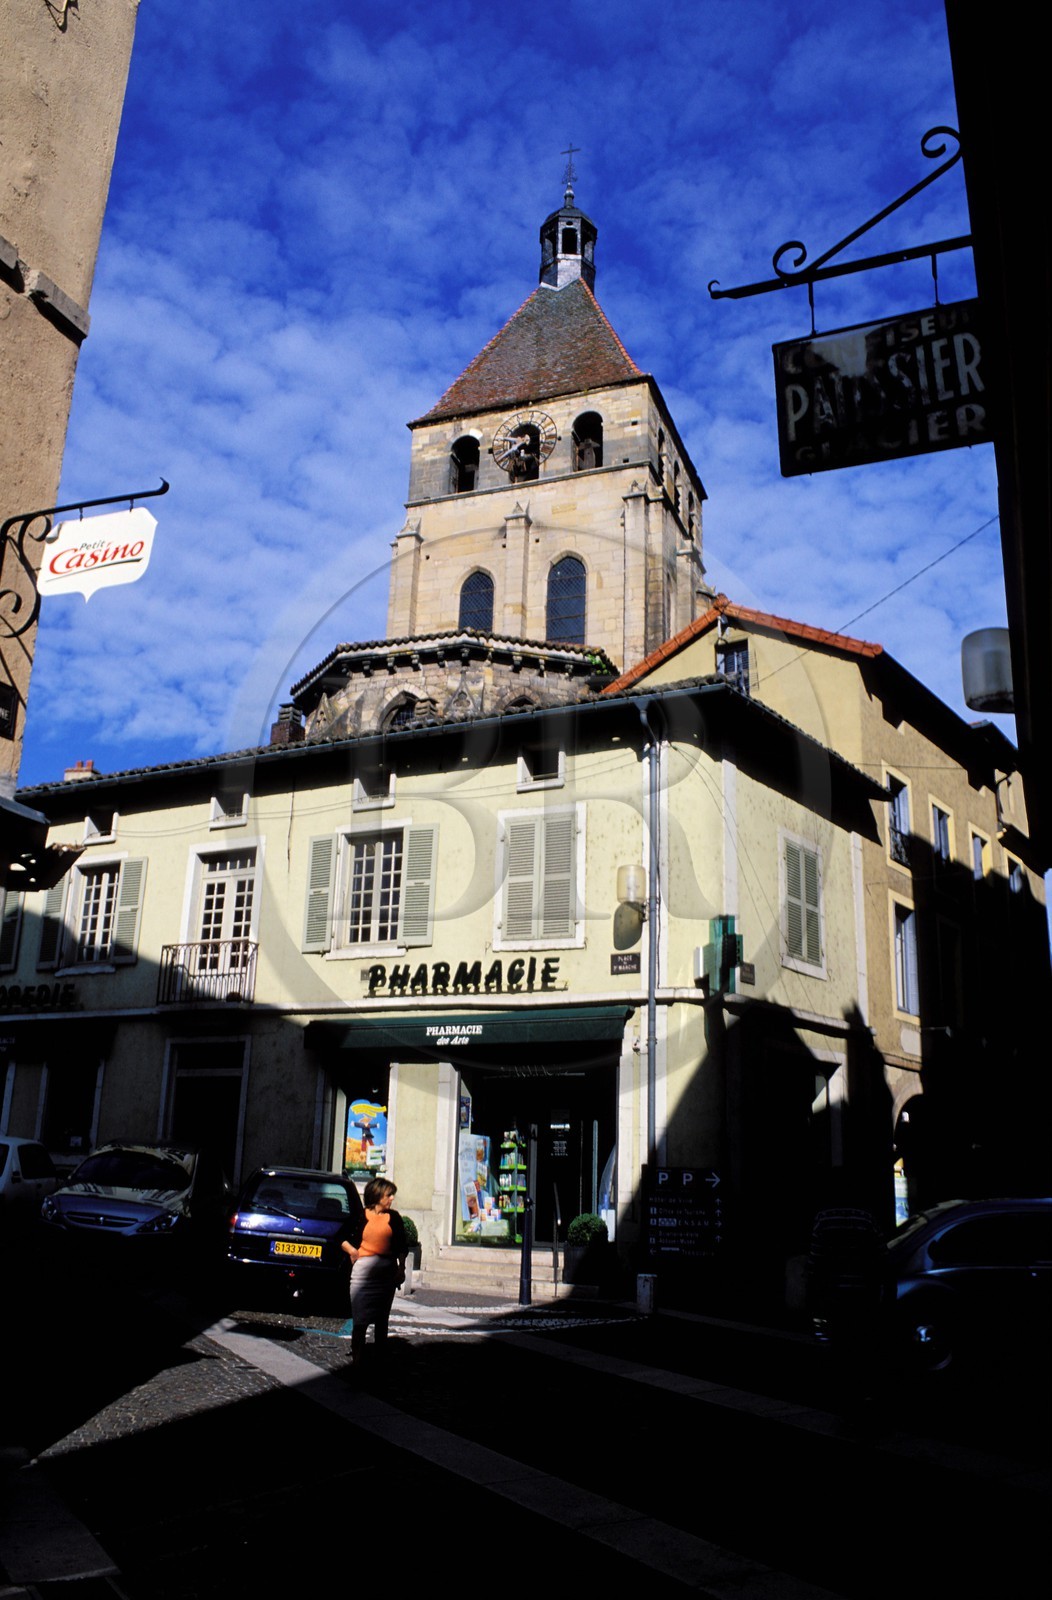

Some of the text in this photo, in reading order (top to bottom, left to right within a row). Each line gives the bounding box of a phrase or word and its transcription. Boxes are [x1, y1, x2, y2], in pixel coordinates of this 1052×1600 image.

[80, 540, 106, 551] Petit
[49, 540, 145, 575] Casino
[368, 956, 560, 990] PHARMACIE
[426, 1025, 483, 1036] PHARMACIE
[436, 1035, 469, 1045] des Arts
[275, 1242, 319, 1256] 6133 XD 71
